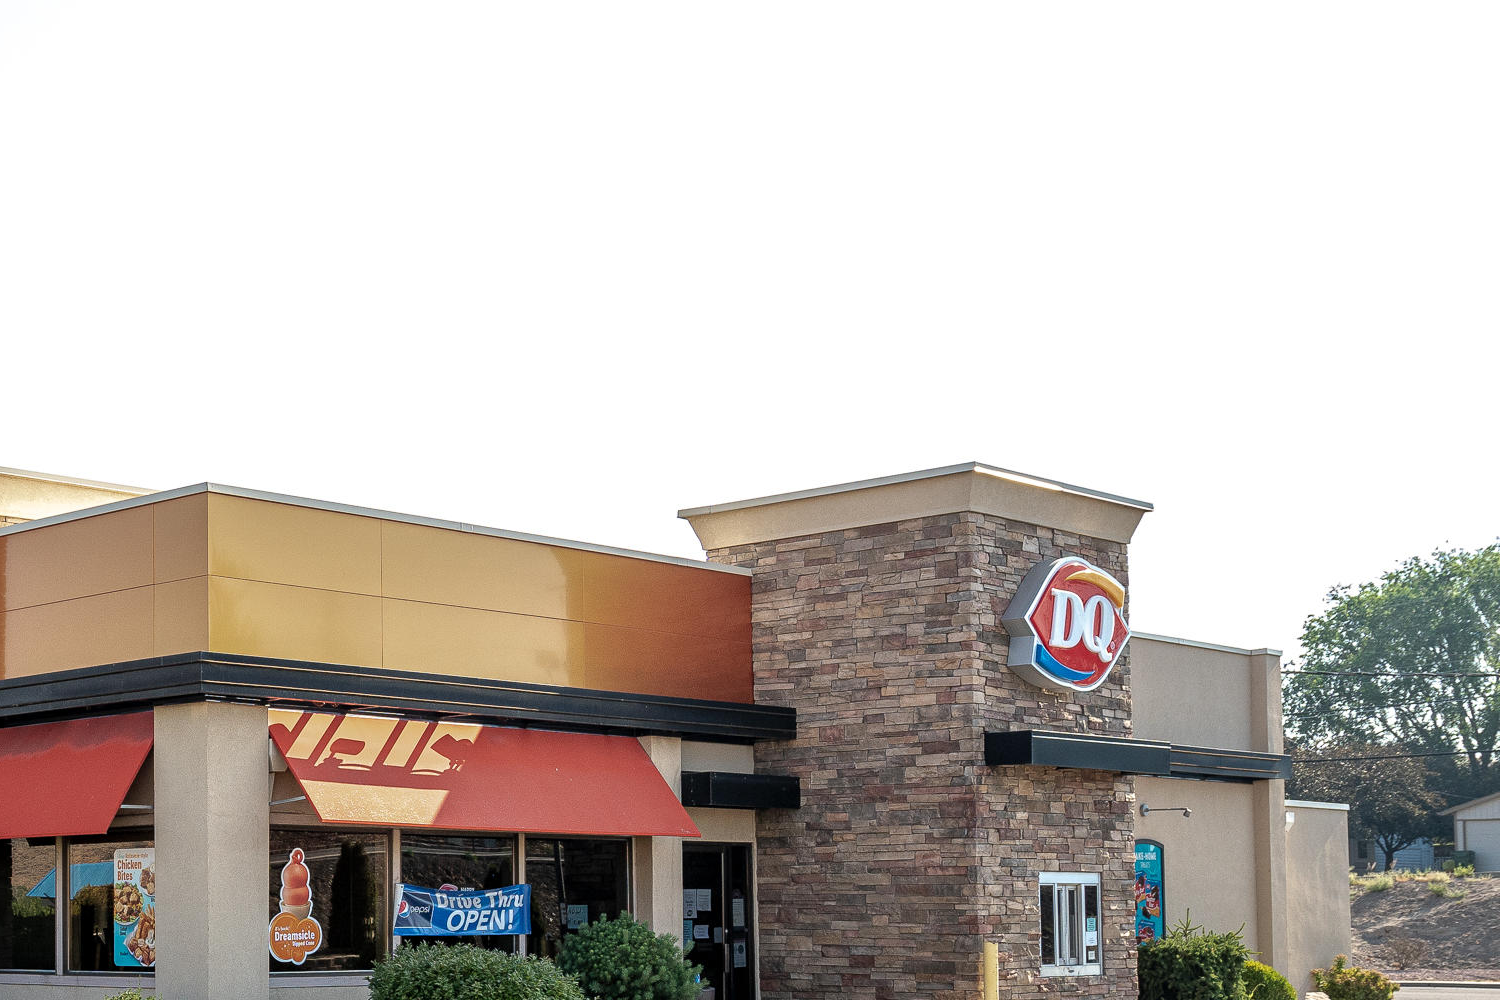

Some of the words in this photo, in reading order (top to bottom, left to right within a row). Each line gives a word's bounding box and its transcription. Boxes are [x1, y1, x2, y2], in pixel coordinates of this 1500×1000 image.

[1049, 588, 1115, 662] DQ
[117, 859, 142, 870] Chicken
[117, 870, 133, 881] Bites
[435, 893, 481, 909] Drive
[485, 890, 524, 908] Thru
[410, 905, 430, 914] pepsi
[446, 909, 514, 932] OPEN!
[274, 929, 315, 942] Dreamsicle
